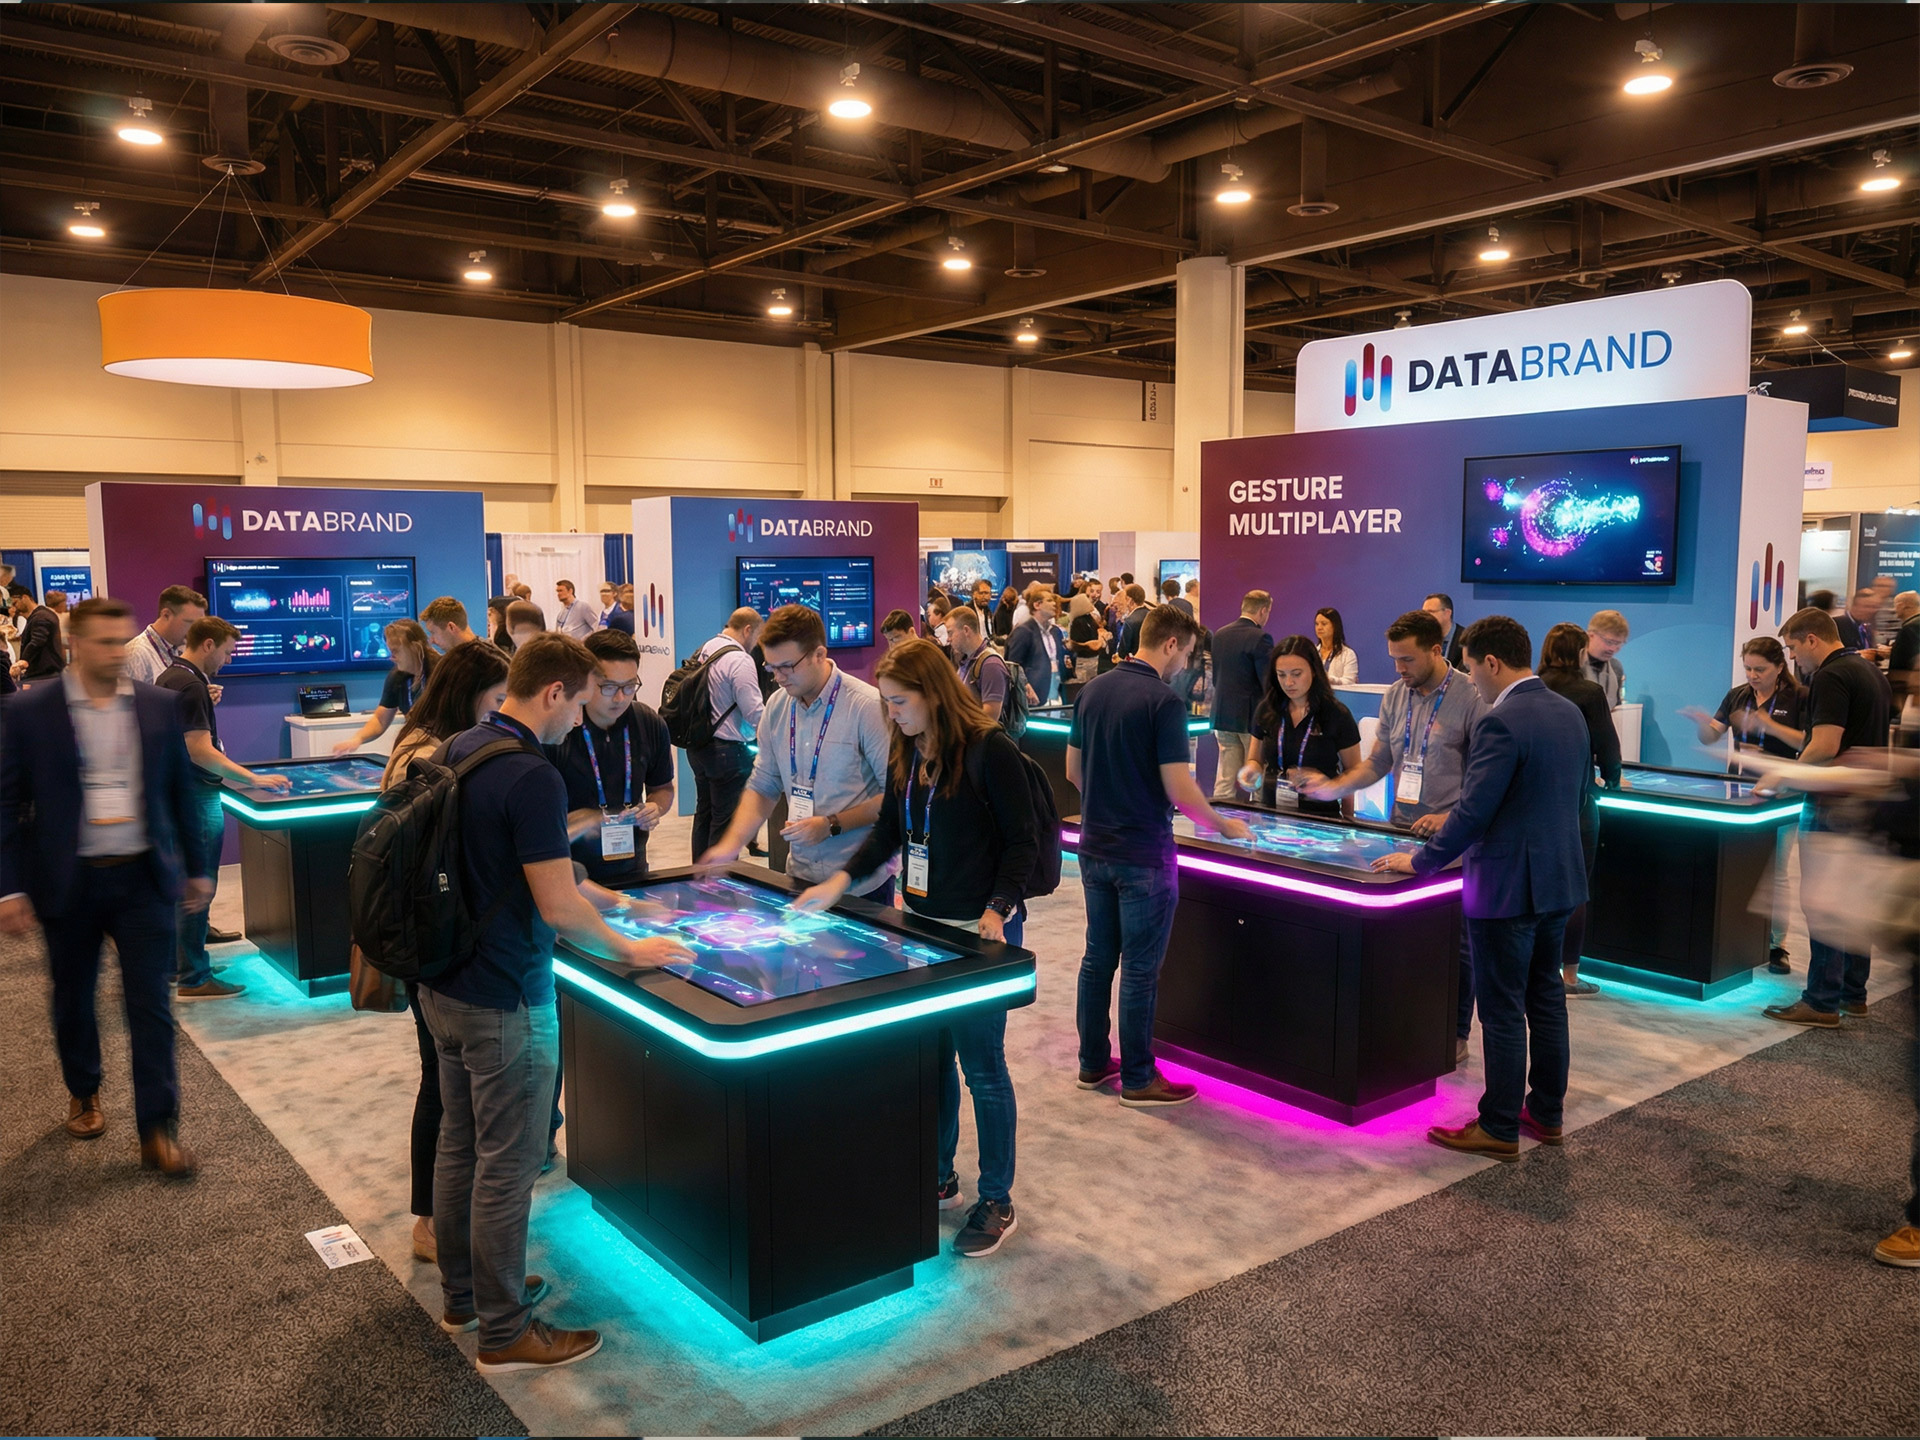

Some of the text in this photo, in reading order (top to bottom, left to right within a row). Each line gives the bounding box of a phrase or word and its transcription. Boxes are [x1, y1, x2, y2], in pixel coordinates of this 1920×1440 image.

[1408, 330, 1673, 393] DATABRAND
[1229, 475, 1343, 504] GESTURE
[242, 510, 413, 532] DATABRAND
[760, 518, 873, 537] DATABRAND
[1229, 508, 1402, 536] MULTIPLAYER
